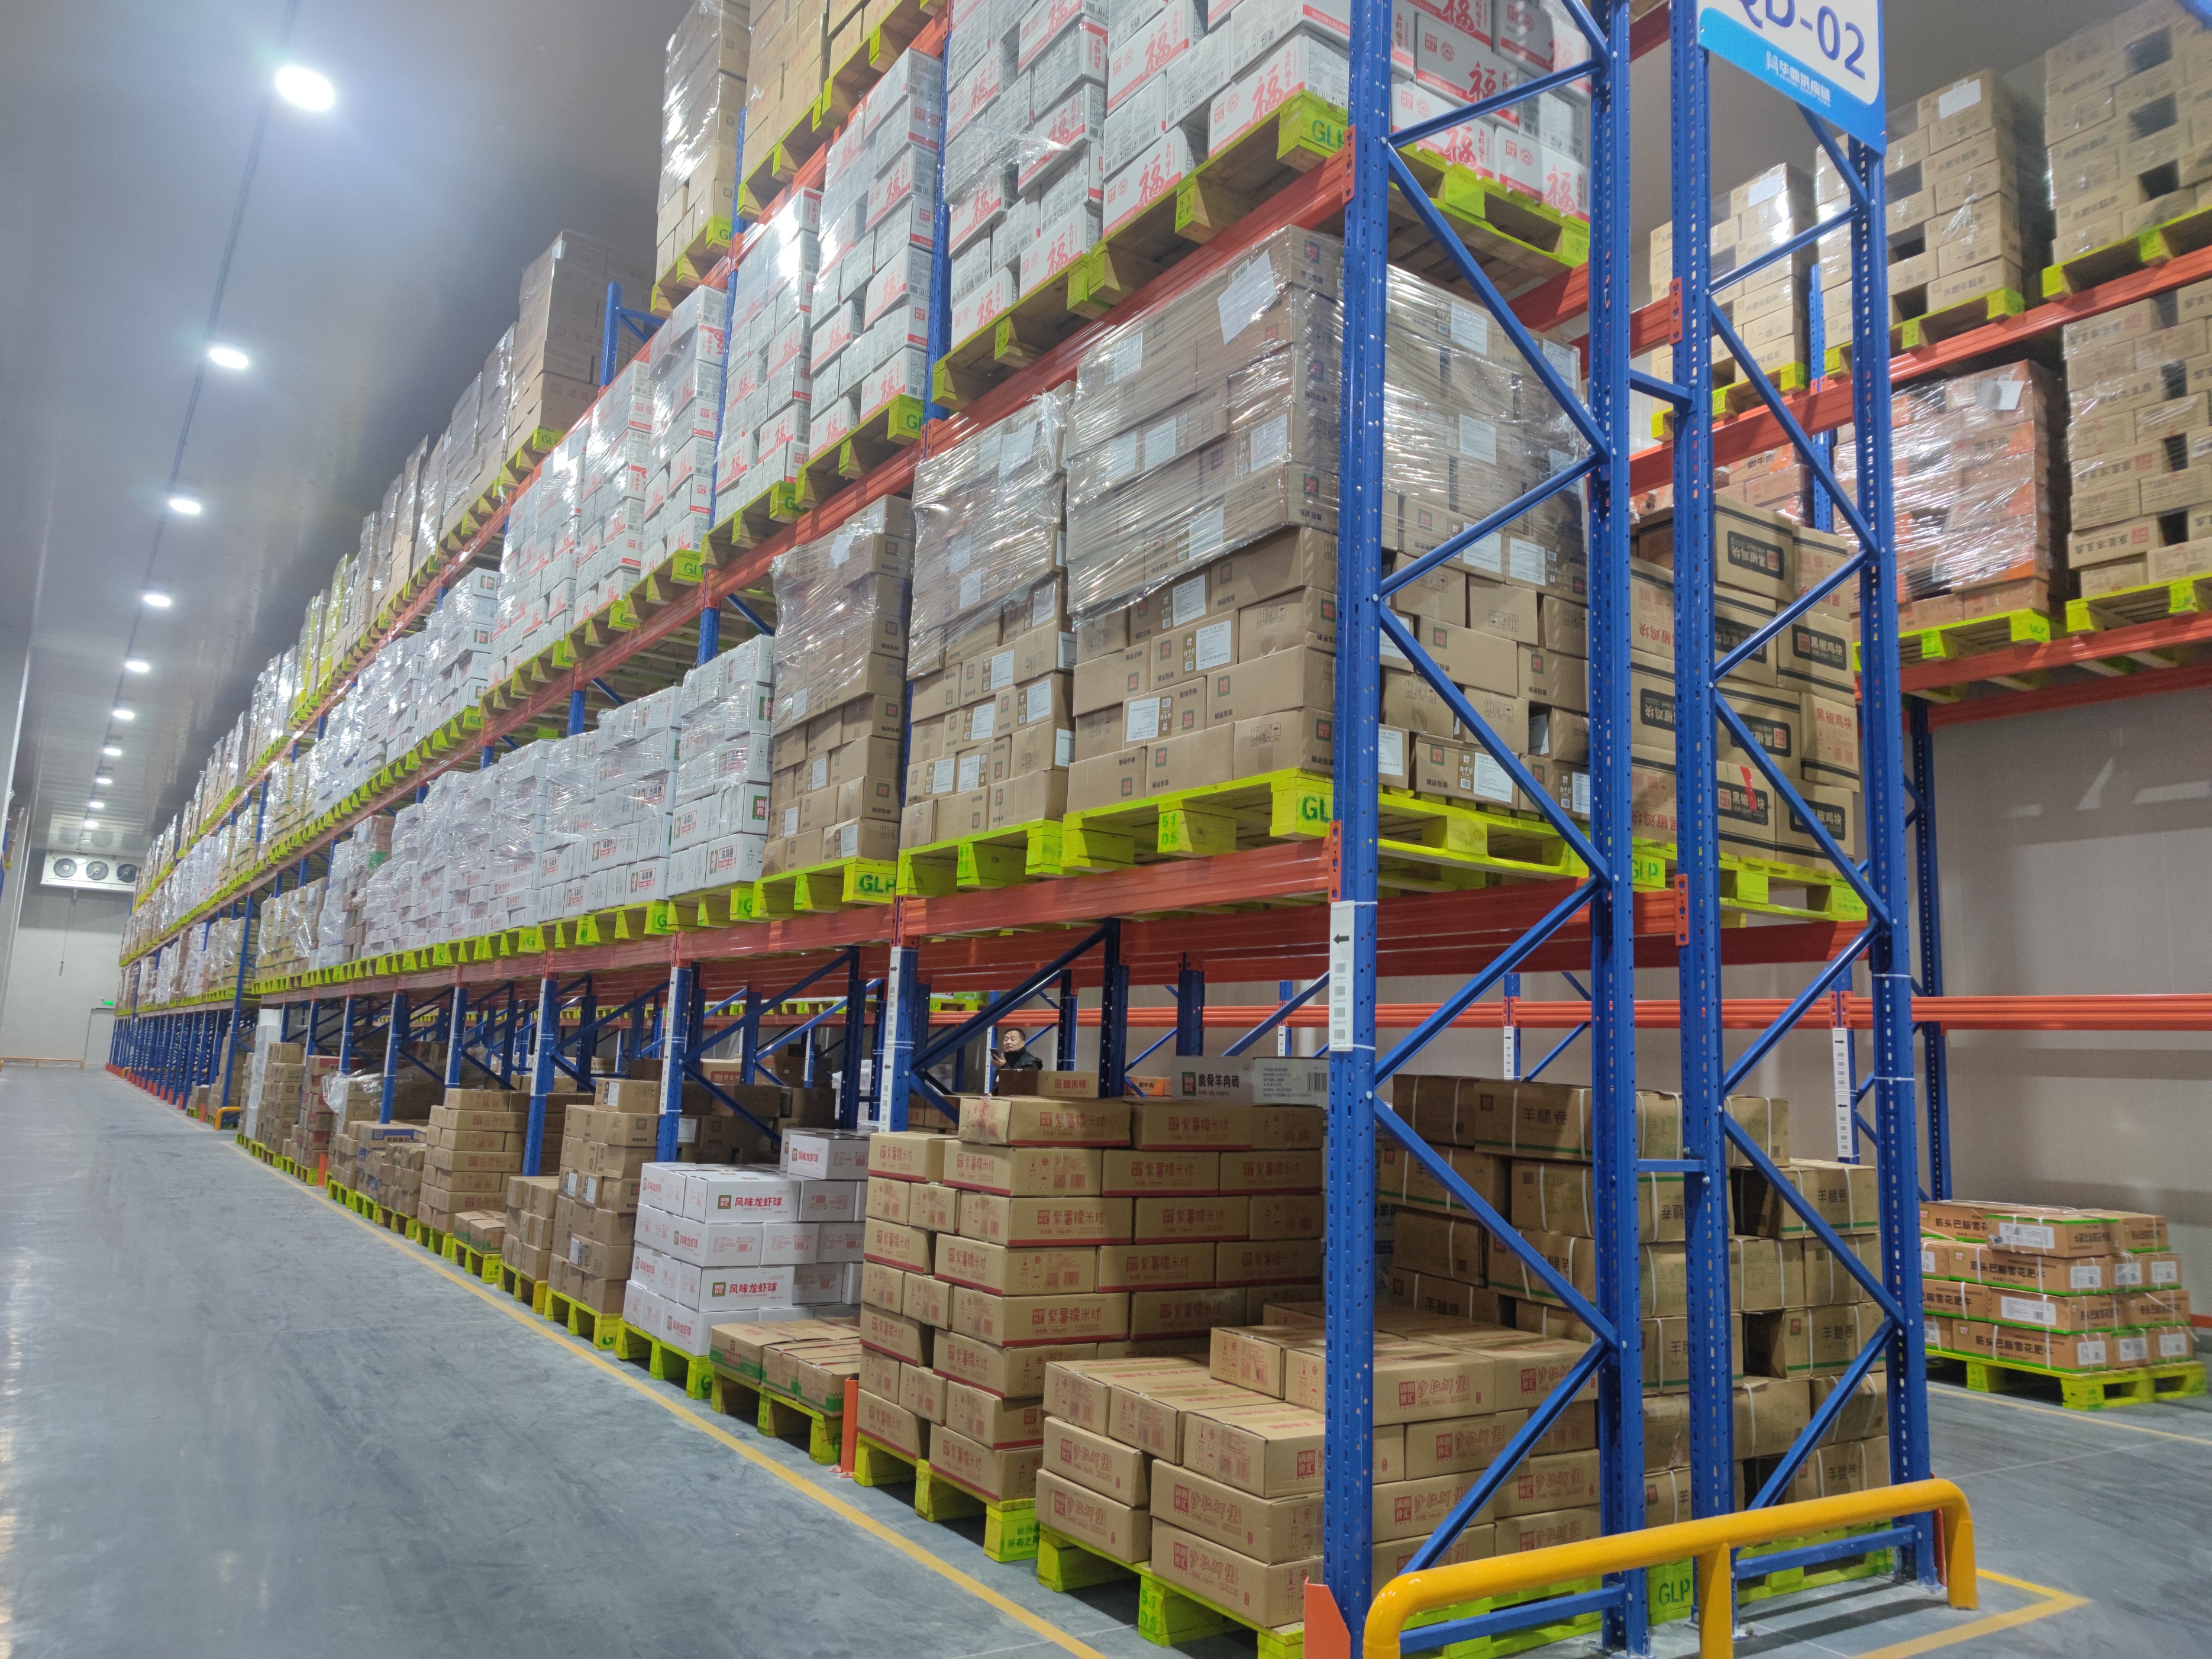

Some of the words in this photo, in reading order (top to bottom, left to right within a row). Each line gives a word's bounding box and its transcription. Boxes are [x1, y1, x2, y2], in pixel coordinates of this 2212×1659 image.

[1143, 21, 1172, 76] 福
[1779, 59, 1830, 102] 华鼎供应链
[1250, 63, 1284, 124] 福
[1312, 119, 1349, 149] GL
[1444, 125, 1478, 169] 福
[1137, 153, 1165, 206] 福
[1545, 164, 1576, 213] 福
[1046, 232, 1068, 279] 福
[977, 289, 996, 333] 福
[1811, 636, 1843, 657] 黑椒鸡块
[1816, 707, 1852, 731] 黑椒鸡块
[1427, 778, 1448, 788] 储运包装
[1732, 791, 1765, 811] 黑椒块
[1063, 1079, 1087, 1089] 甜不辣
[1138, 1081, 1155, 1089] 嫩牛肉
[1199, 1073, 1240, 1089] 脆骨羊肉砖
[1055, 1112, 1107, 1128] 紫薯糯米球
[1523, 1107, 1567, 1124] 羊腿卷
[798, 1150, 819, 1164] 风味龙虾球
[965, 1155, 995, 1173] 紫薯糯米球
[734, 1197, 783, 1207] 风味龙虾球
[1817, 1188, 1848, 1203] 羊腿卷
[1052, 1210, 1106, 1226] 紫薯糯米球
[679, 1234, 699, 1251] 风味龙虾球
[728, 1282, 777, 1295] 风味龙虾球
[1048, 1307, 1102, 1324] 紫薯糯米球
[672, 1319, 692, 1337] 风味龙虾球
[1823, 1325, 1855, 1341] 羊腿卷
[1538, 1363, 1575, 1386] 沙拉虾
[1418, 1375, 1467, 1398] 沙拉虾堡
[1455, 1425, 1502, 1450] 沙拉虾堡
[1074, 1444, 1109, 1471] 沙拉虾堡
[1536, 1468, 1580, 1492] 沙拉虾堡
[1067, 1496, 1103, 1525] 沙拉虾堡
[1191, 1491, 1238, 1524] 沙拉虾堡
[1190, 1550, 1235, 1584] 沙拉虾堡
[1658, 1579, 1691, 1606] GLP
